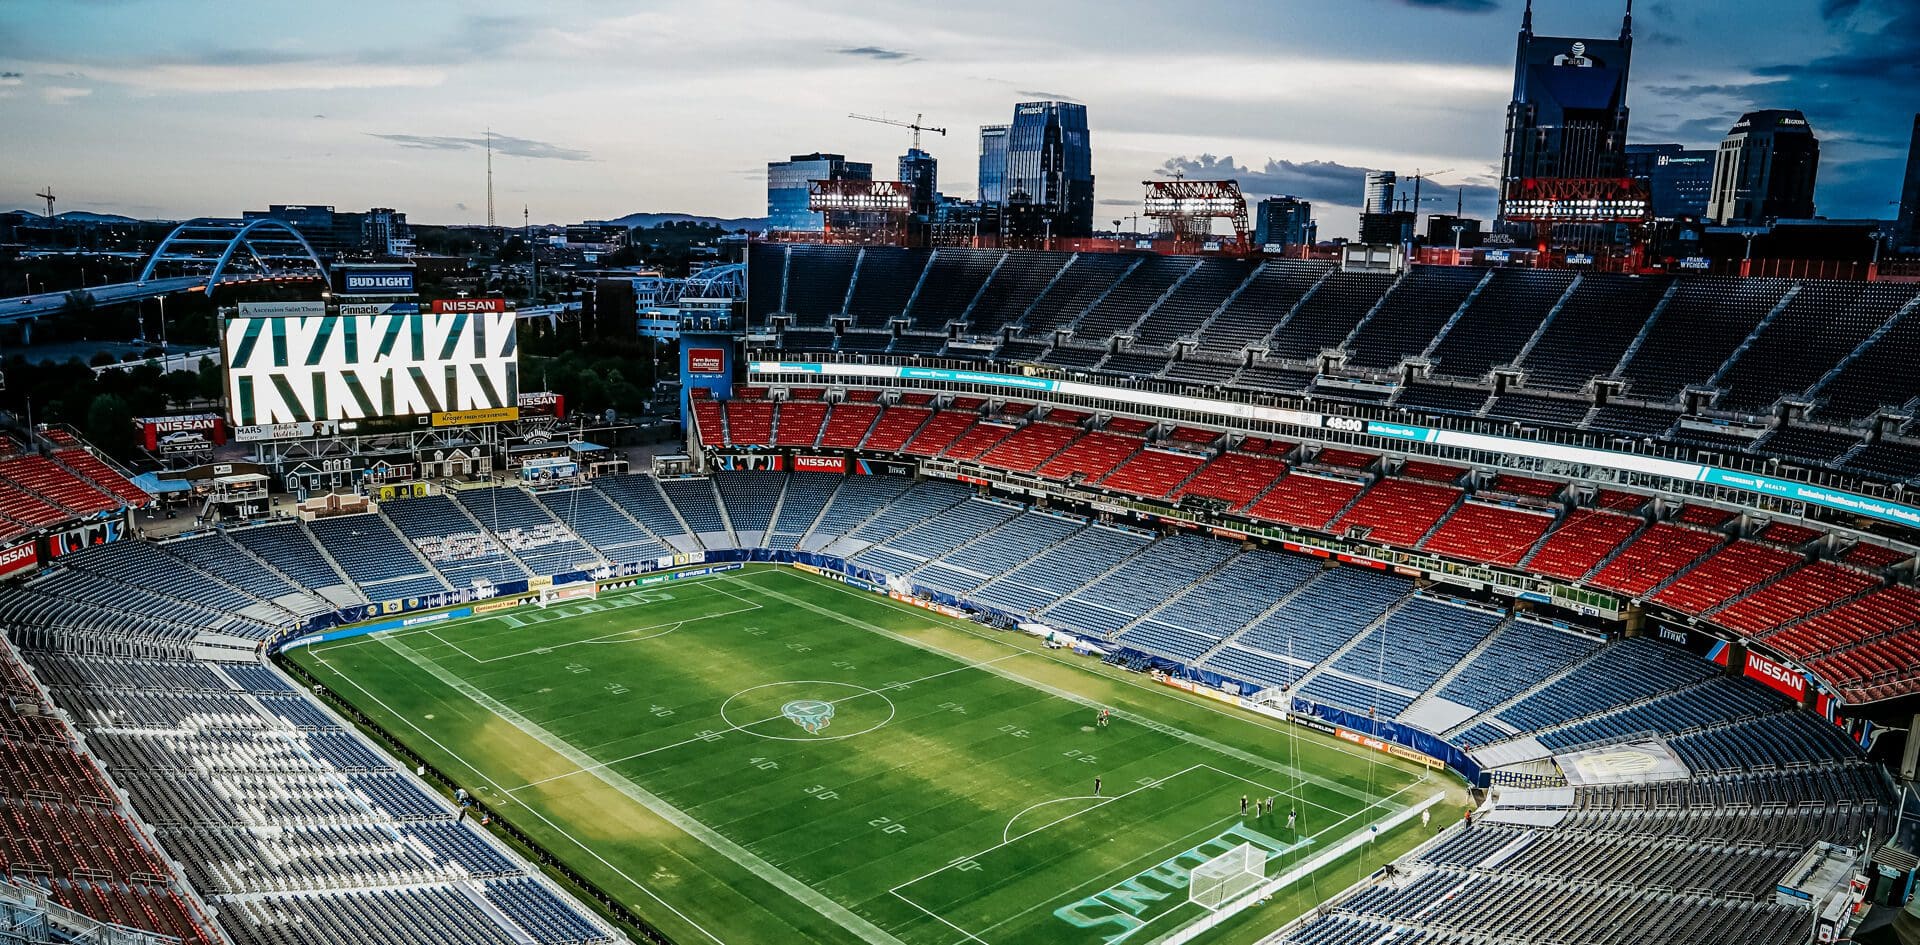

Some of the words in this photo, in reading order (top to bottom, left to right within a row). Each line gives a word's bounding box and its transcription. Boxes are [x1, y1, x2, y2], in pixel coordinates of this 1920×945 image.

[349, 277, 375, 288] BUD
[376, 277, 410, 287] LIGHT
[252, 305, 284, 314] Ascension
[285, 305, 300, 313] Saint
[340, 305, 379, 315] Pinnacle
[442, 301, 496, 312] NISSAN
[443, 413, 463, 424] Kroger
[1326, 416, 1363, 432] 48:00
[156, 419, 215, 432] NISSAN
[237, 426, 262, 435] MARS
[176, 443, 209, 451] TITAN
[797, 458, 842, 468] NISSAN
[887, 465, 906, 475] TITANS
[1764, 482, 1787, 492] HEALTH
[1886, 506, 1894, 515] of
[1658, 625, 1687, 645] TITANS
[1748, 655, 1804, 691] NISSAN
[1308, 721, 1335, 735] JEWELERS
[1389, 745, 1424, 761] Continental
[1429, 758, 1443, 768] TIRE
[750, 757, 776, 770] 40
[804, 784, 836, 801] 30
[868, 816, 904, 835] 20
